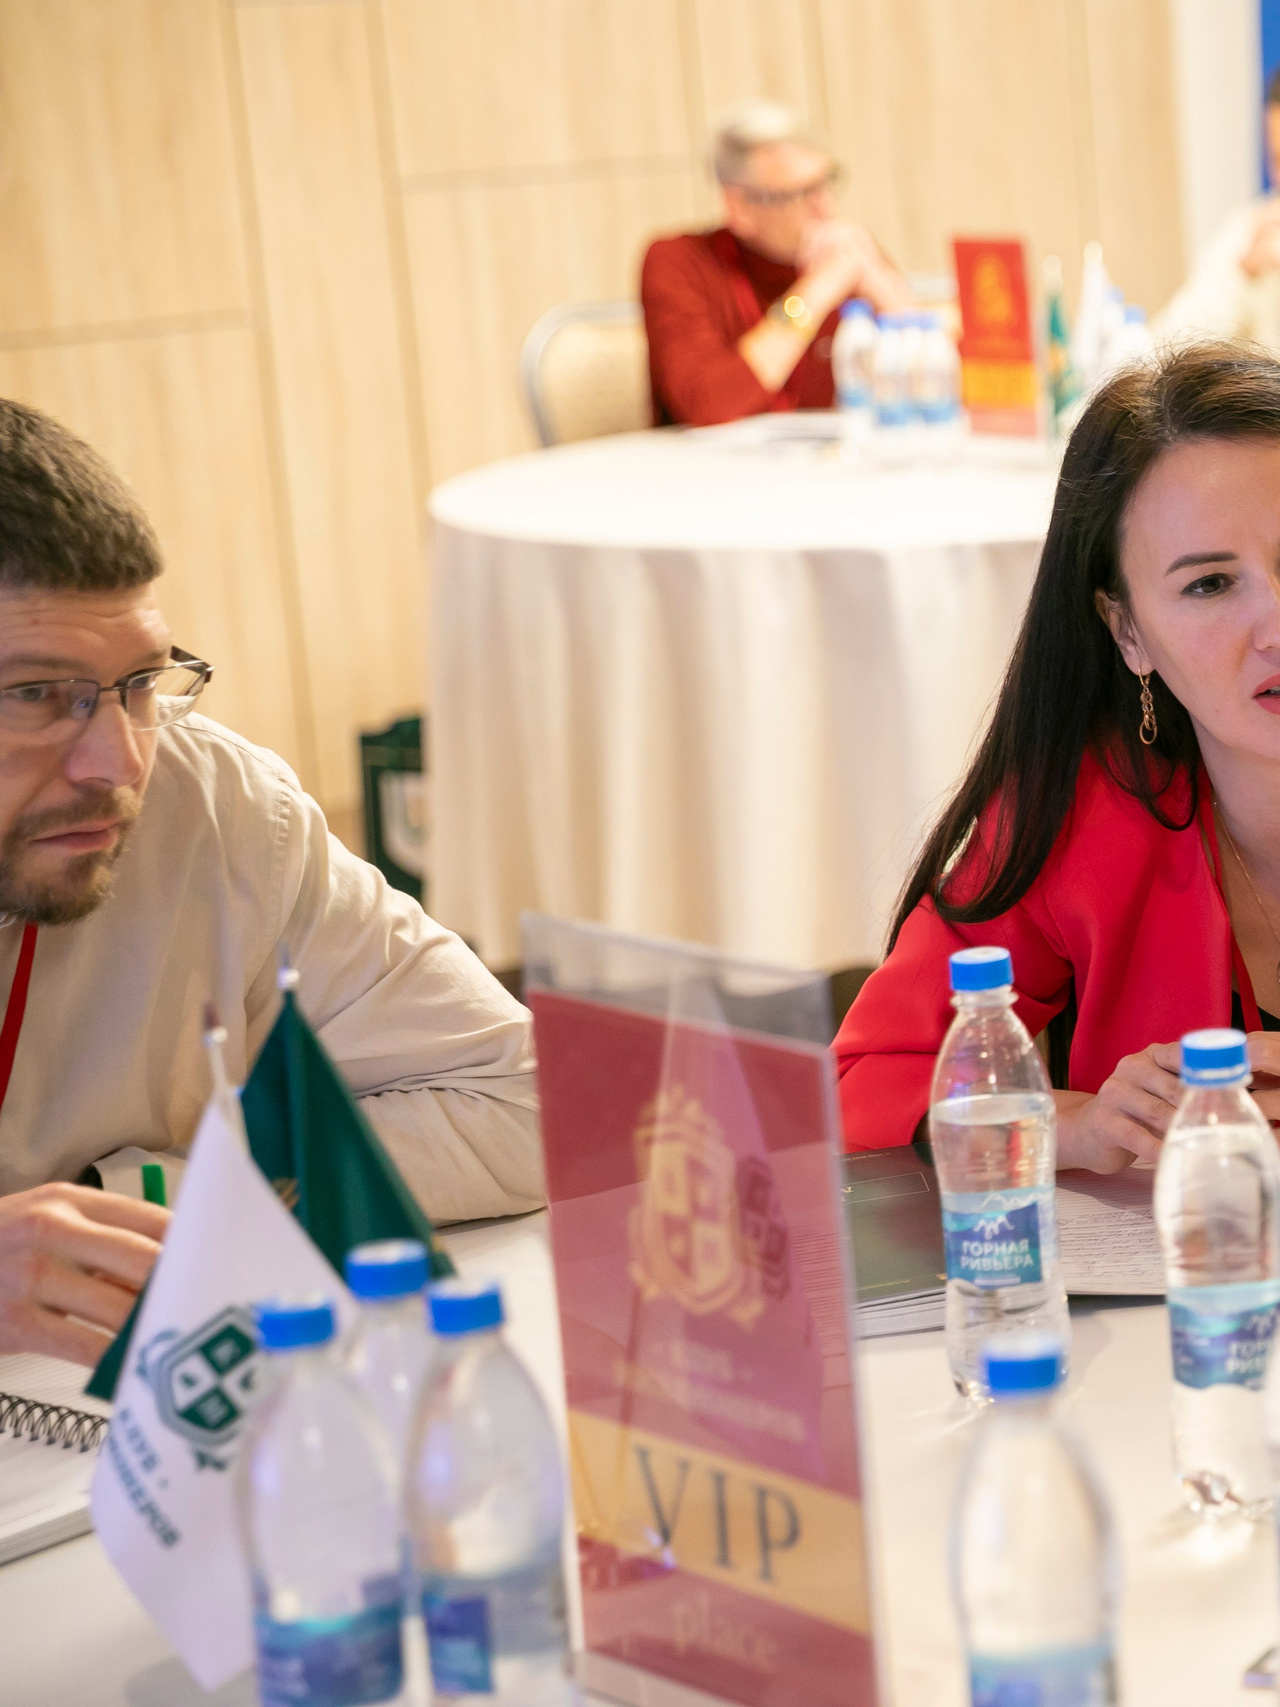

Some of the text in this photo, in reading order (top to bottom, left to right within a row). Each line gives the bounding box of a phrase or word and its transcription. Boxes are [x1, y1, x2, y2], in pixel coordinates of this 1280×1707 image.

[962, 1238, 1029, 1257] ГОРНАЯ
[960, 1254, 1035, 1272] РИВЬЕРА
[633, 1443, 803, 1584] VIP
